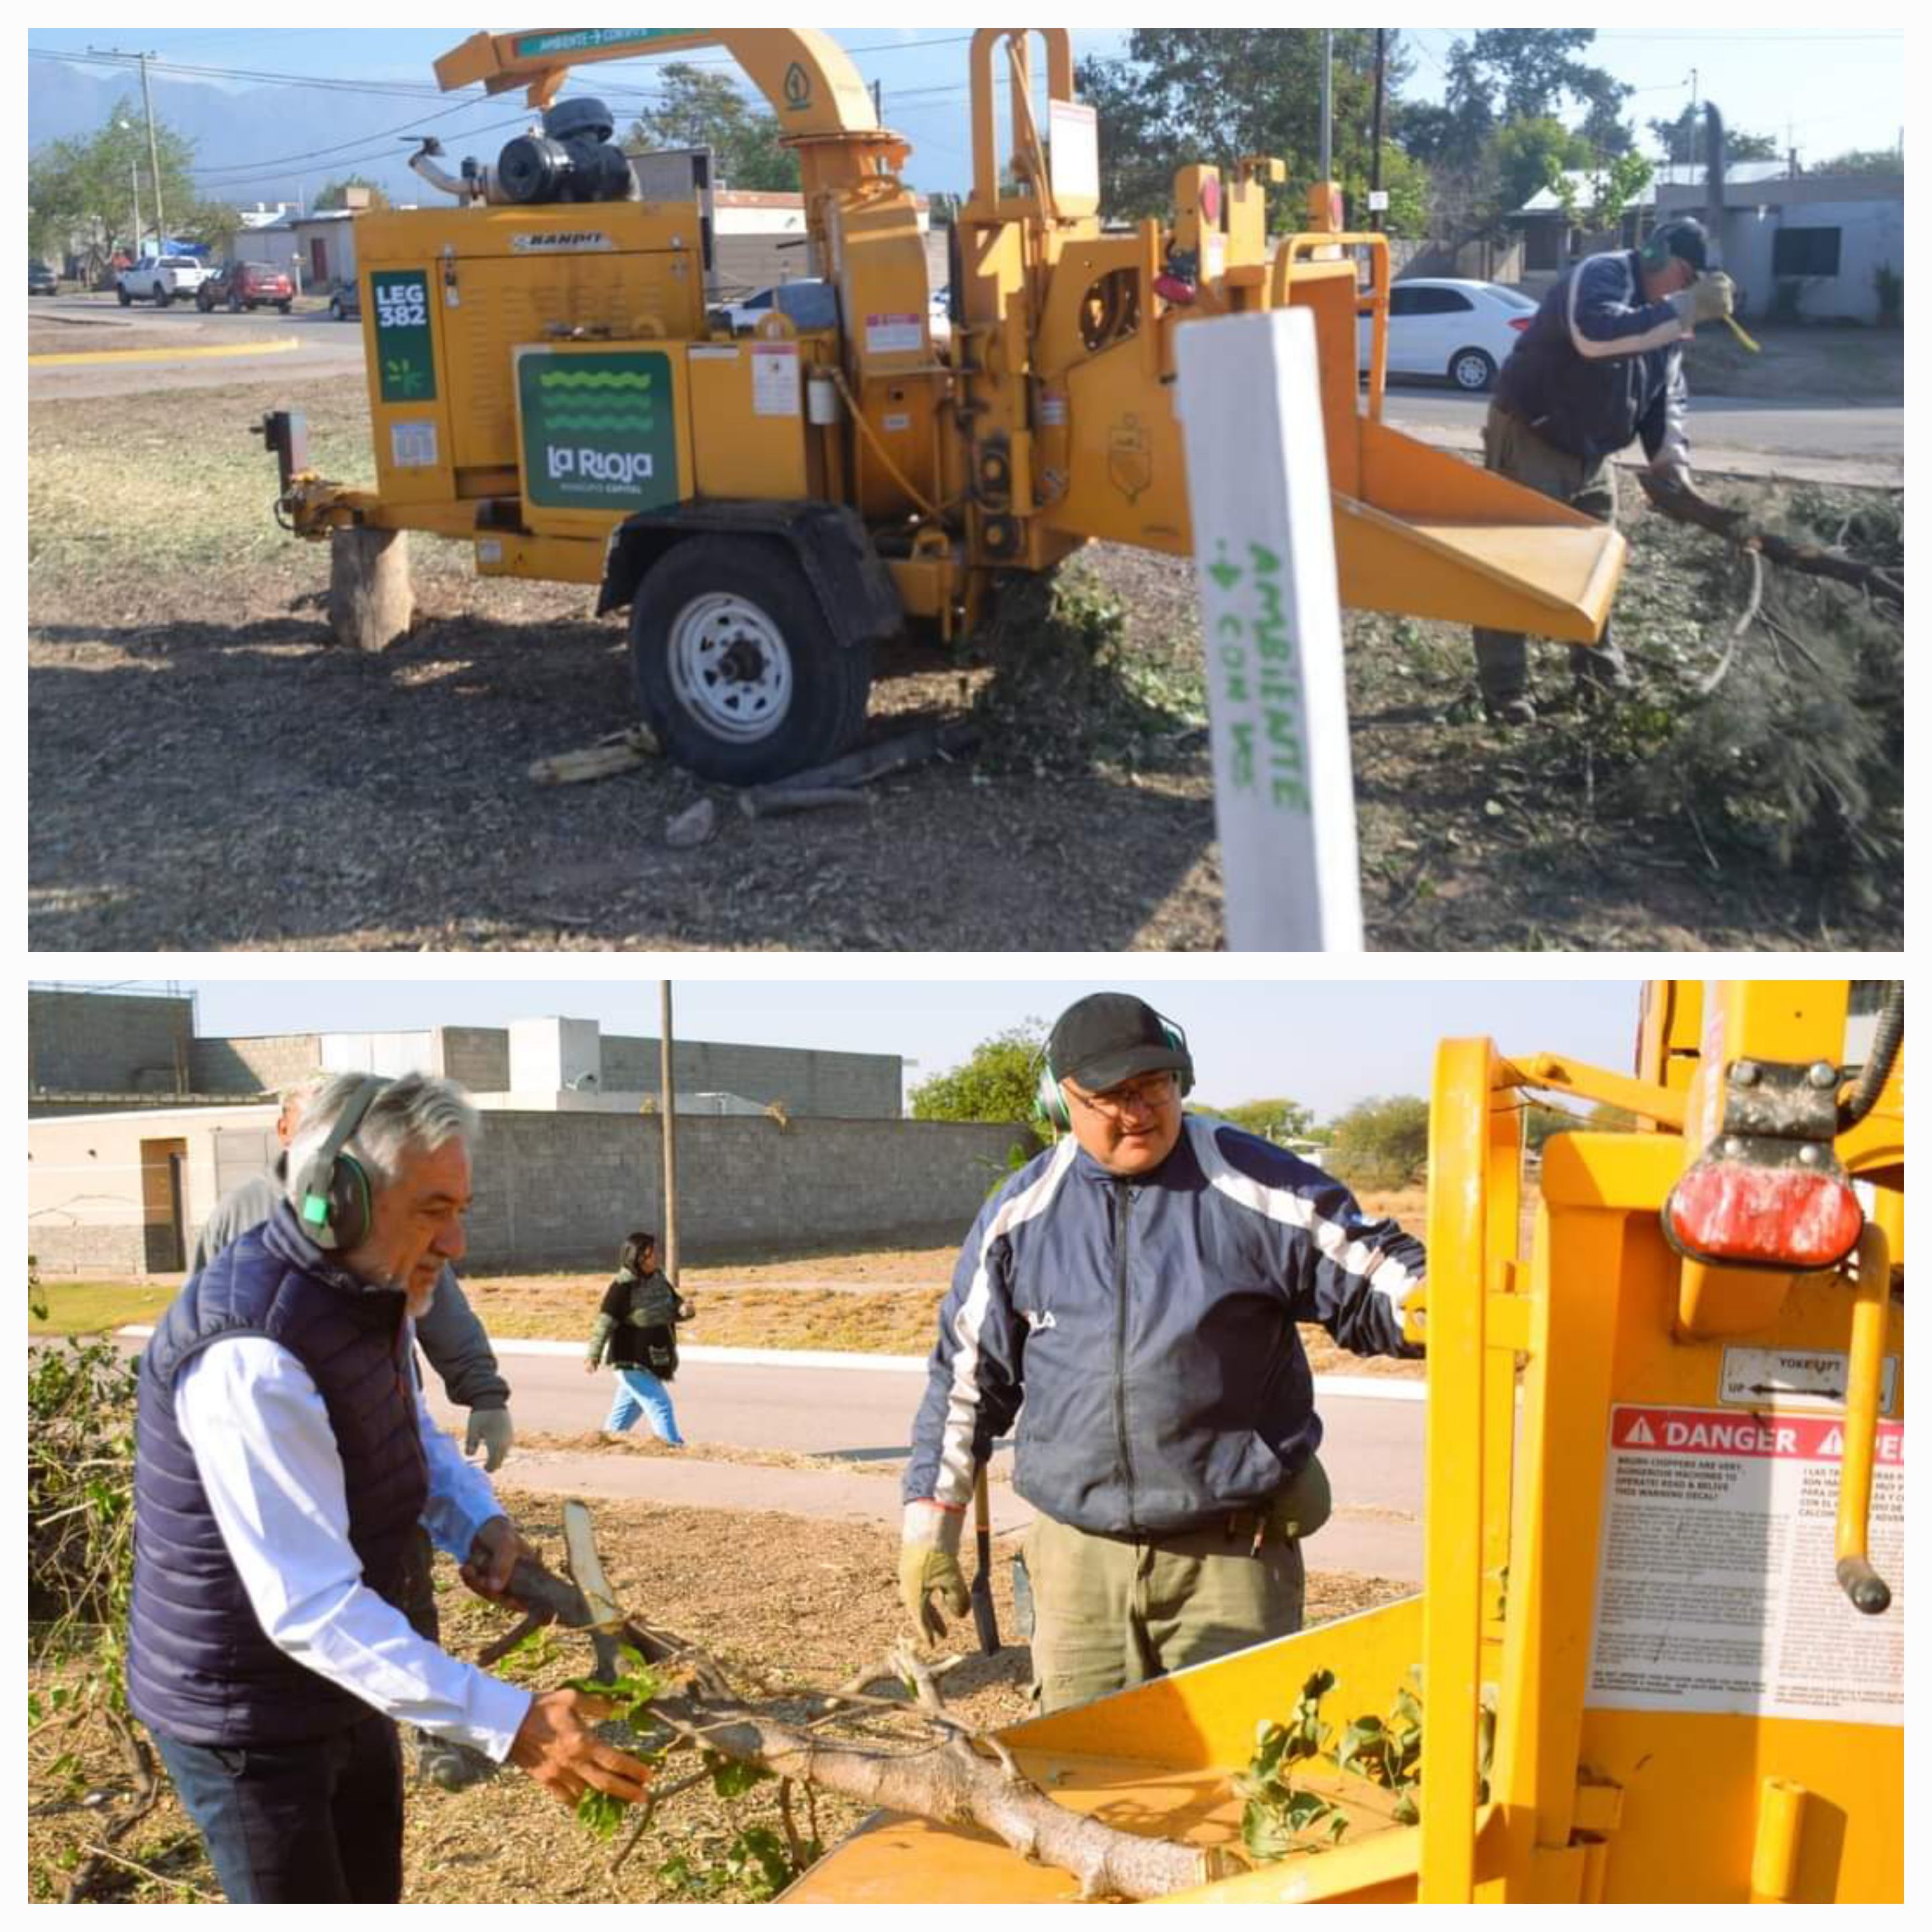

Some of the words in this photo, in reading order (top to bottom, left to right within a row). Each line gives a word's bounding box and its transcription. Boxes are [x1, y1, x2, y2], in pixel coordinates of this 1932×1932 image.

[376, 284, 425, 304] LEG
[379, 305, 427, 328] 382
[1728, 1383, 1744, 1393] UP
[1666, 1422, 1797, 1454] DANGER
[1699, 1460, 1715, 1469] ARE
